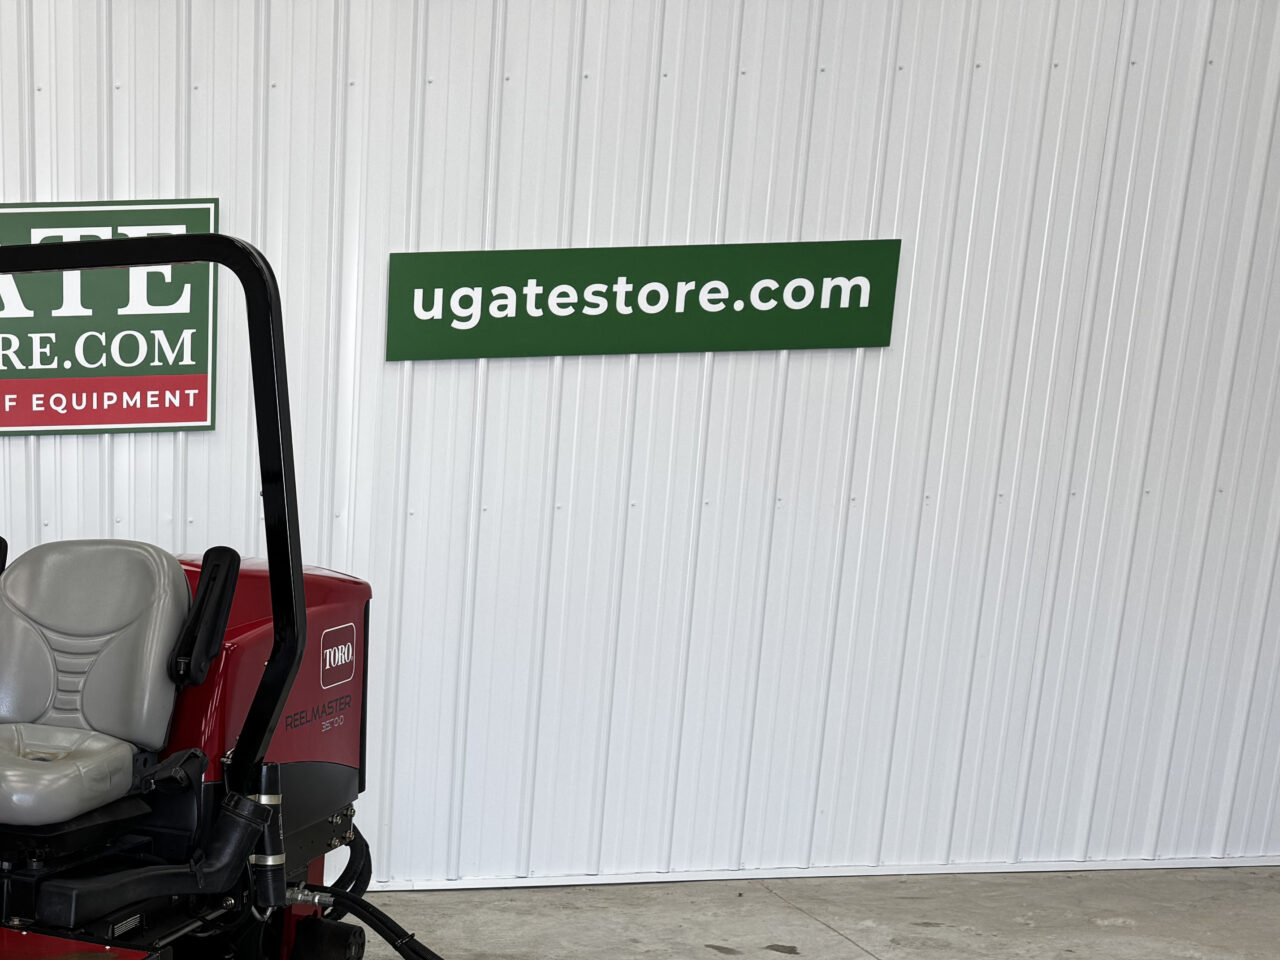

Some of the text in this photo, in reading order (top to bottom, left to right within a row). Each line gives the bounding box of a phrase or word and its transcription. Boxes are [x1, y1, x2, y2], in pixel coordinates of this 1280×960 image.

[413, 275, 871, 330] ugatestore.com
[32, 389, 199, 414] EQUIPMENT
[324, 642, 352, 670] TORO
[285, 695, 352, 731] REELMASTER
